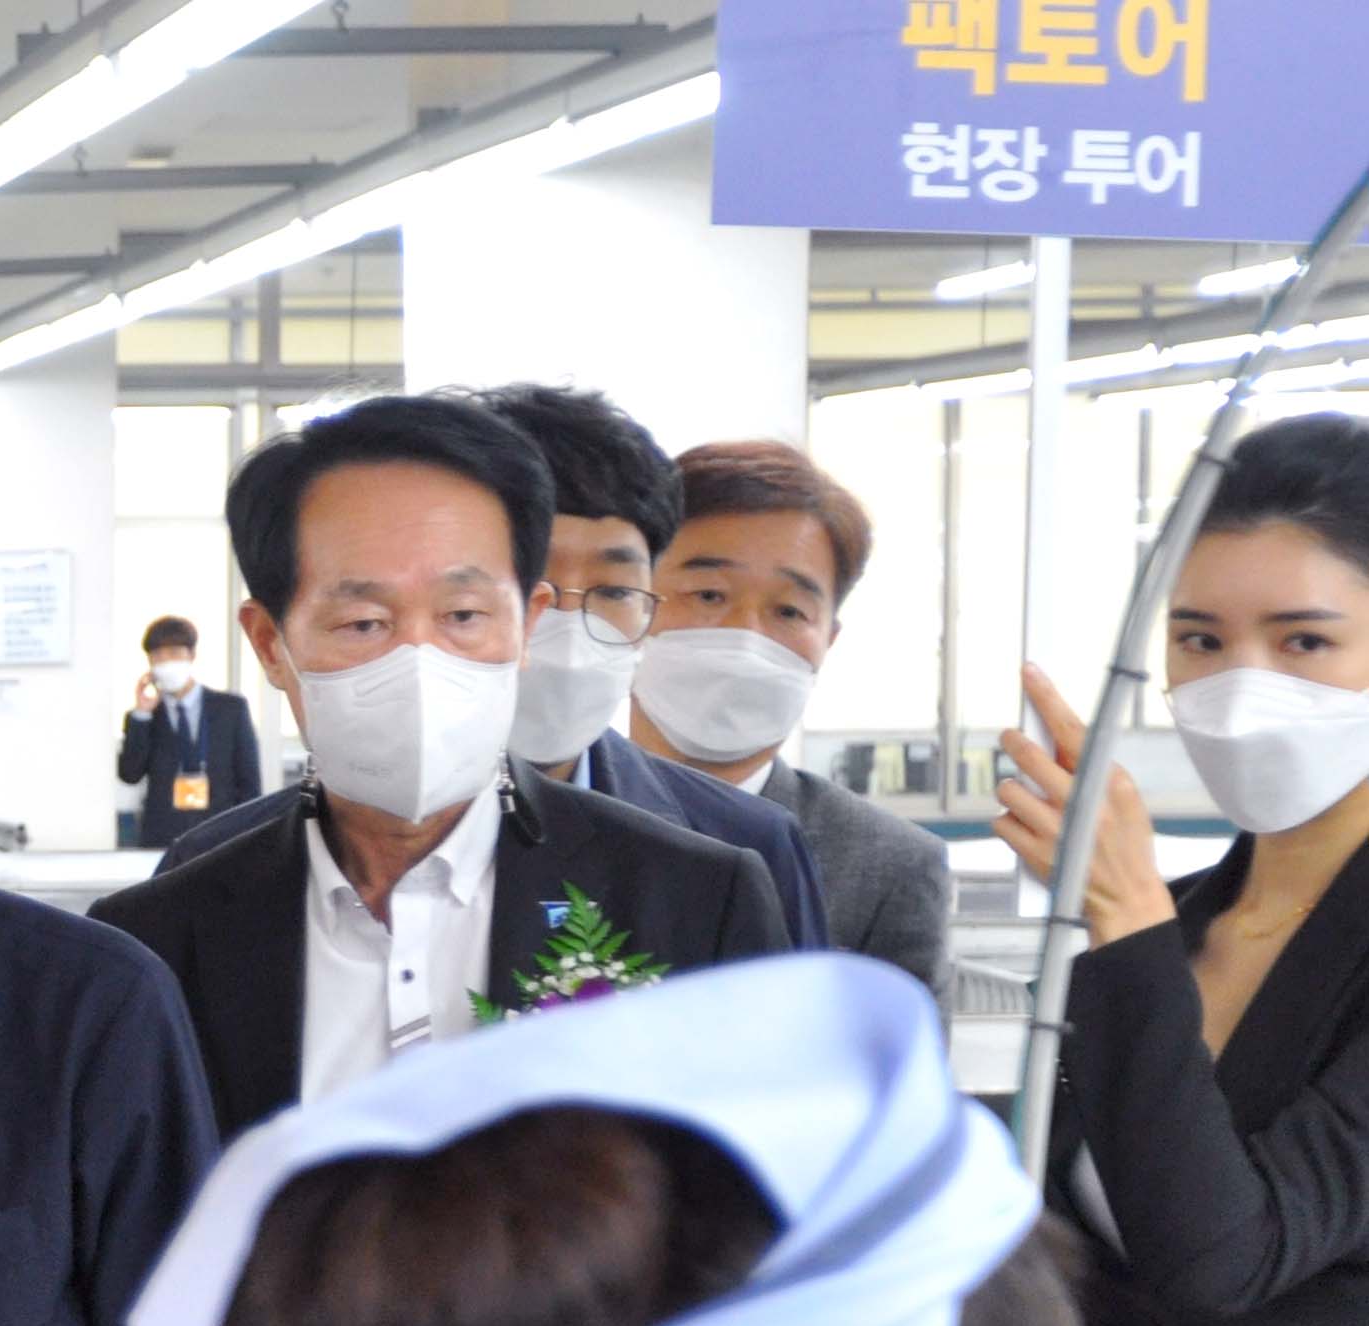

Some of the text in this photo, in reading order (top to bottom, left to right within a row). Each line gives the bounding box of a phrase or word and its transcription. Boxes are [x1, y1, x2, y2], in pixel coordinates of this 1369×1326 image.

[900, 0, 1210, 103] 팩토어
[901, 122, 1202, 207] 현장 투어
